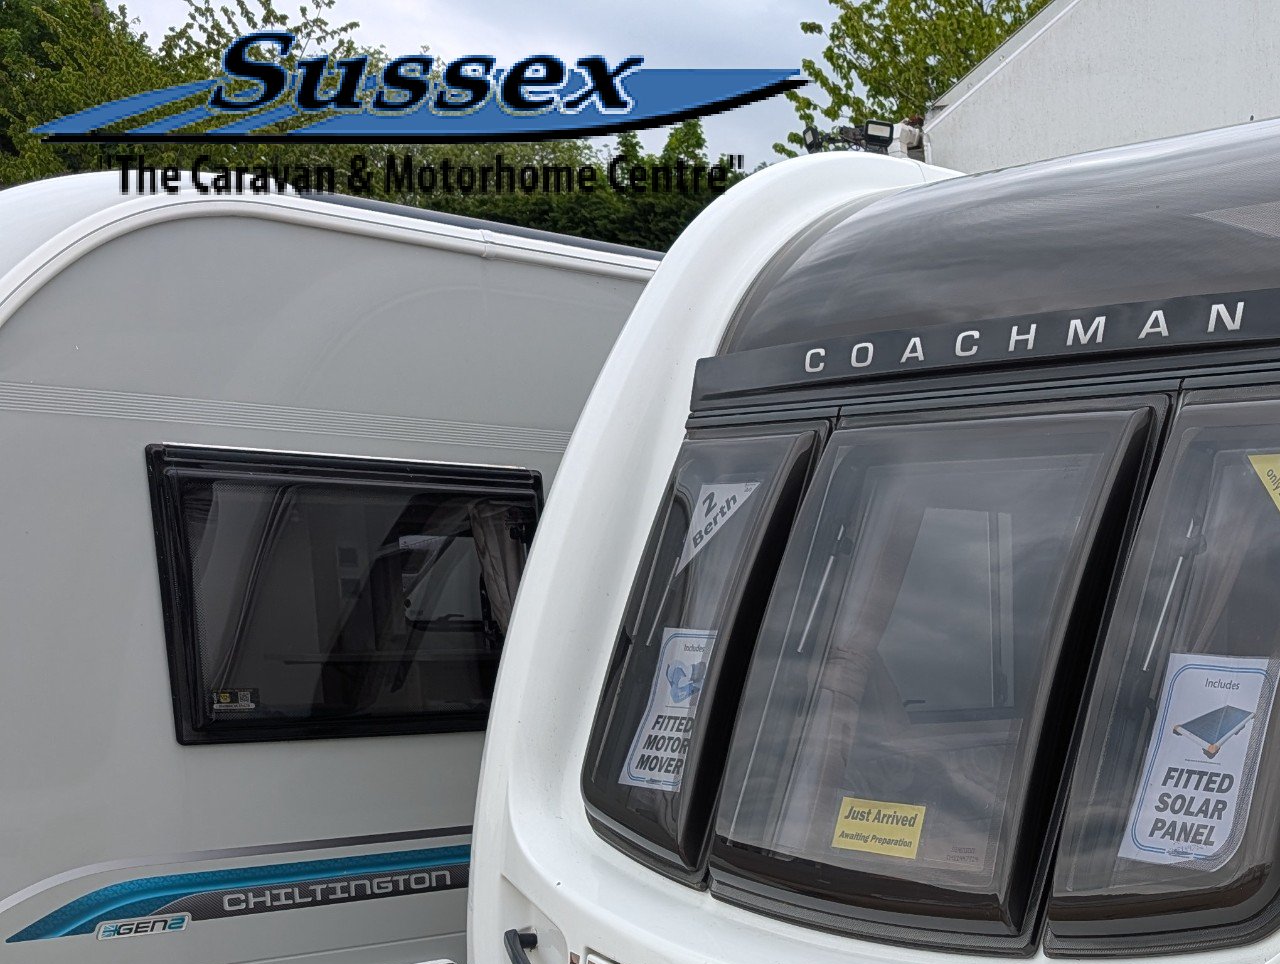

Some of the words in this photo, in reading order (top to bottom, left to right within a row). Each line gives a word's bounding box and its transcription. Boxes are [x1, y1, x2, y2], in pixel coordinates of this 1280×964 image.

[804, 301, 1246, 374] COACHMAN
[702, 491, 718, 518] 2
[692, 494, 738, 549] Berth
[1205, 677, 1241, 691] Includes
[651, 714, 695, 733] FITTED
[642, 734, 691, 754] MOTOR
[635, 753, 685, 775] MOVER
[1161, 766, 1235, 794] FITTED
[844, 805, 872, 823] Just
[872, 808, 918, 828] Arrived
[1154, 792, 1228, 821] SOLAR
[839, 830, 871, 843] Awaiting
[870, 834, 913, 848] Preparation
[1148, 817, 1216, 847] PANEL
[222, 870, 452, 911] CHILTINGTON
